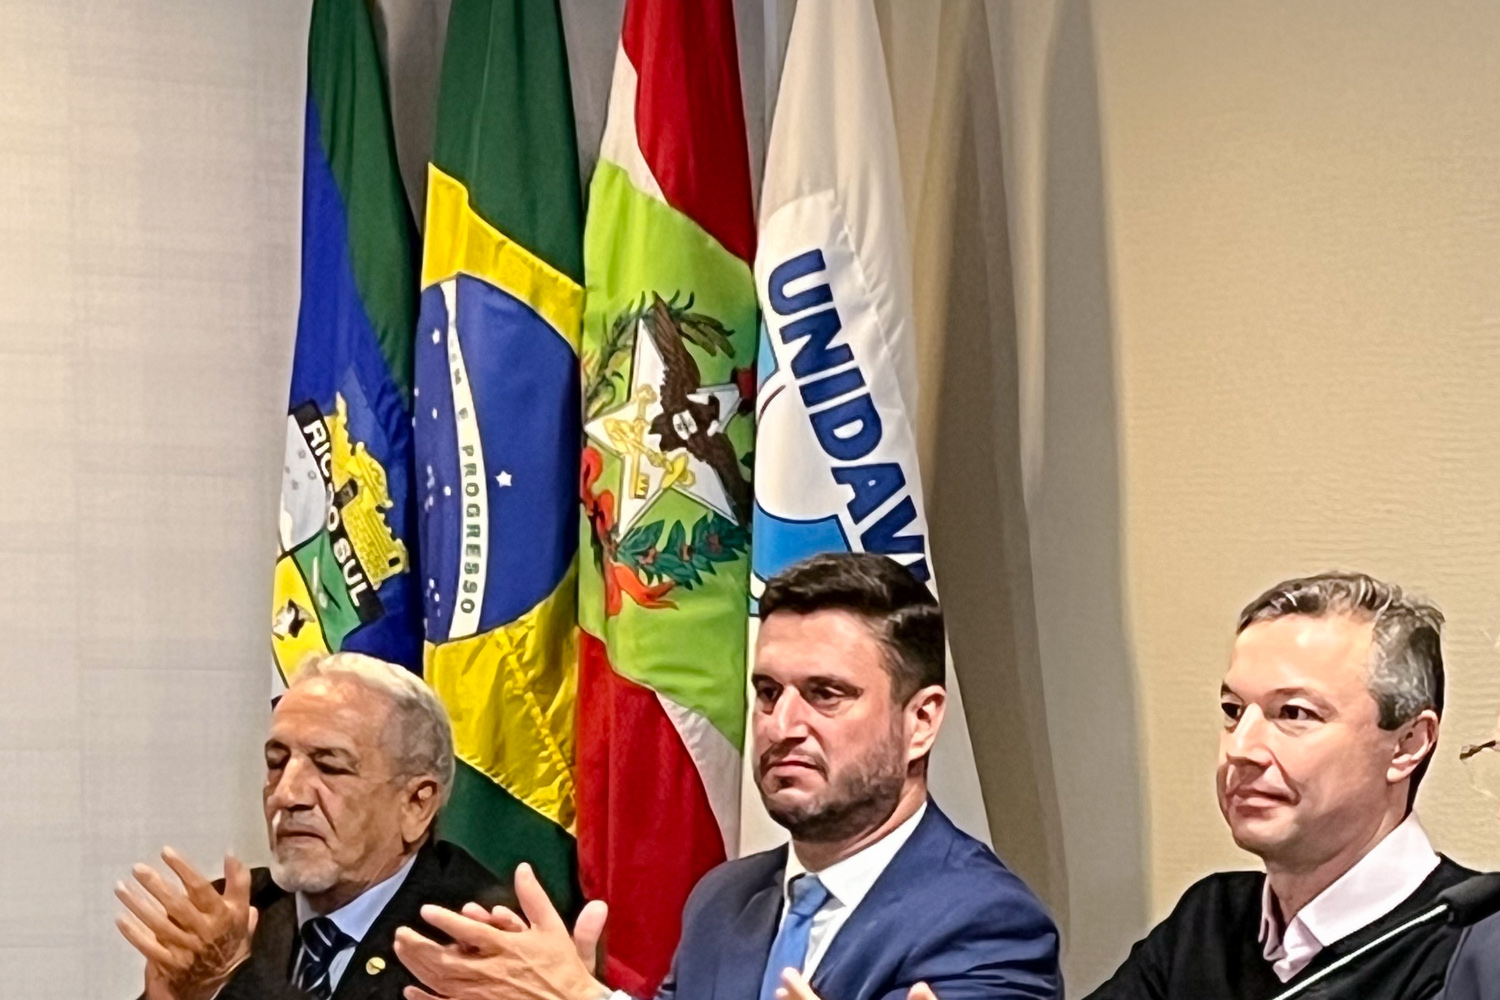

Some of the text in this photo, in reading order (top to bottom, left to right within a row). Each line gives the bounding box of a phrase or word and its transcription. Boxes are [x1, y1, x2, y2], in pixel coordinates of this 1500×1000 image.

[303, 419, 332, 478] RIO
[333, 538, 367, 607] SUL
[461, 444, 482, 614] PROGRESSO
